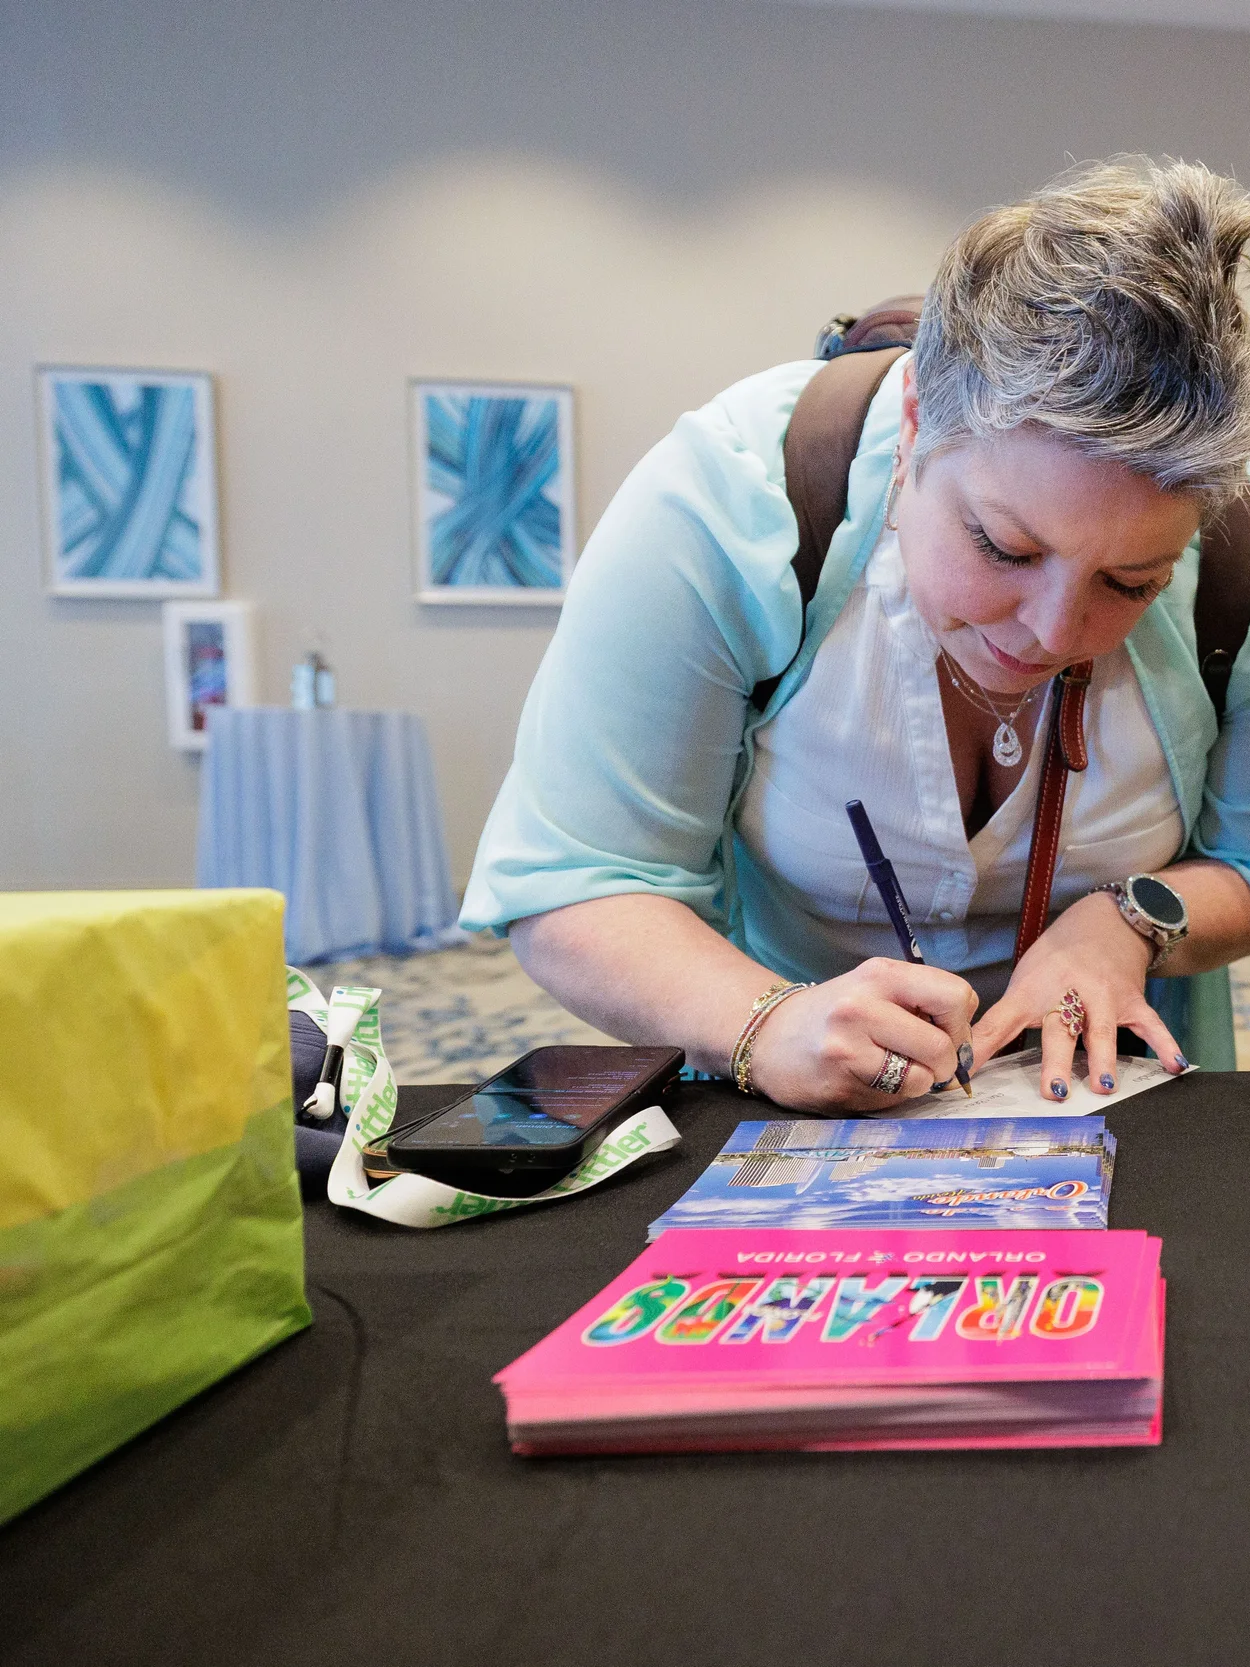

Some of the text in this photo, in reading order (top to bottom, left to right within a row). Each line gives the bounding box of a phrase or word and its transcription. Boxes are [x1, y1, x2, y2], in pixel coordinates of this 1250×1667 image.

[927, 1180, 1088, 1206] Orlando
[736, 1250, 1046, 1264] ORLANDO FLORIDA
[581, 1273, 1103, 1348] ORLANDO
